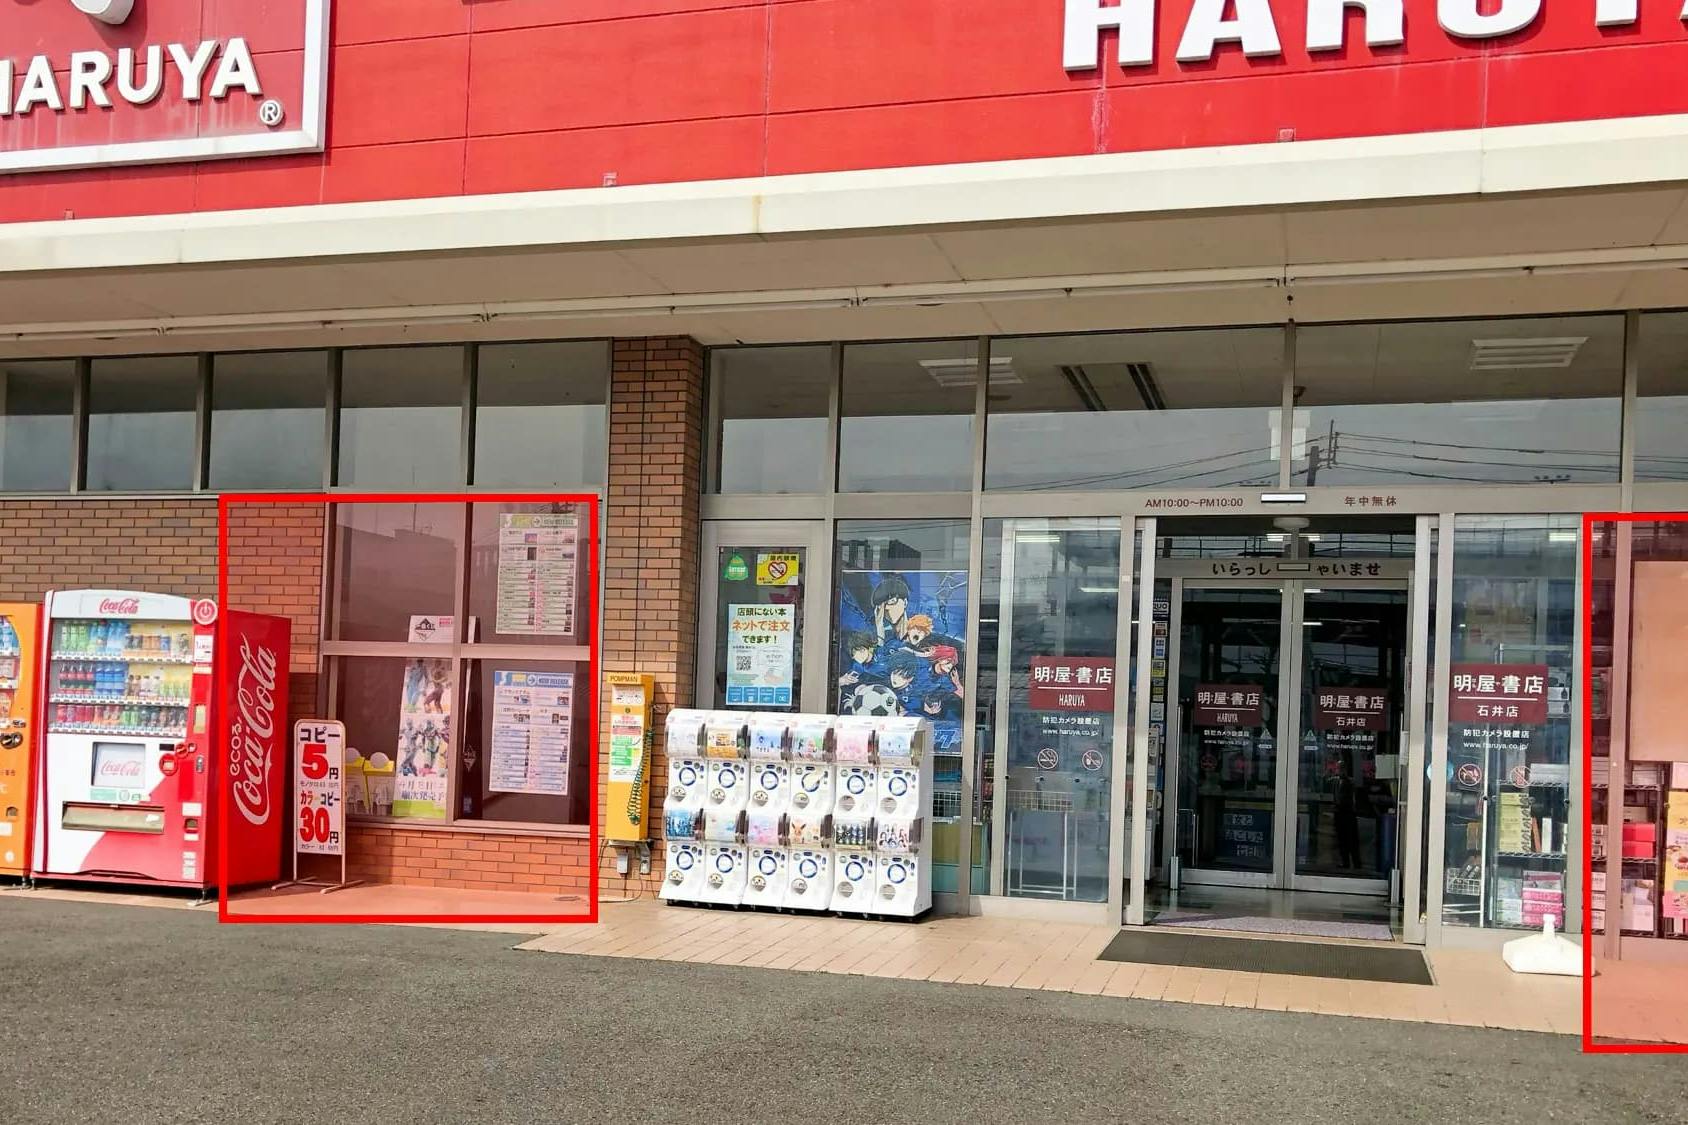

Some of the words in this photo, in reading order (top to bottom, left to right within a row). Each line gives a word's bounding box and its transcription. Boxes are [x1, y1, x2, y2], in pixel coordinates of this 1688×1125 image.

[1344, 495, 1397, 507] 年中無休
[737, 607, 787, 617] 店頭にない本
[732, 619, 790, 632] ネットで注文
[1034, 666, 1113, 684] 明屋書店
[1453, 674, 1544, 694] 明屋書店
[1059, 694, 1085, 706] HARUYA
[1197, 691, 1260, 706] 明屋書店
[1320, 695, 1385, 709] 明屋書店
[1477, 705, 1519, 717] 石井店
[1042, 716, 1100, 725] 防犯カメラ設置店
[1216, 712, 1239, 723] HARUYA
[1336, 716, 1366, 727] 石井店
[299, 726, 340, 743] コピー
[1463, 729, 1530, 739] 防犯カメラ設置店
[300, 790, 340, 806] カラーコピー
